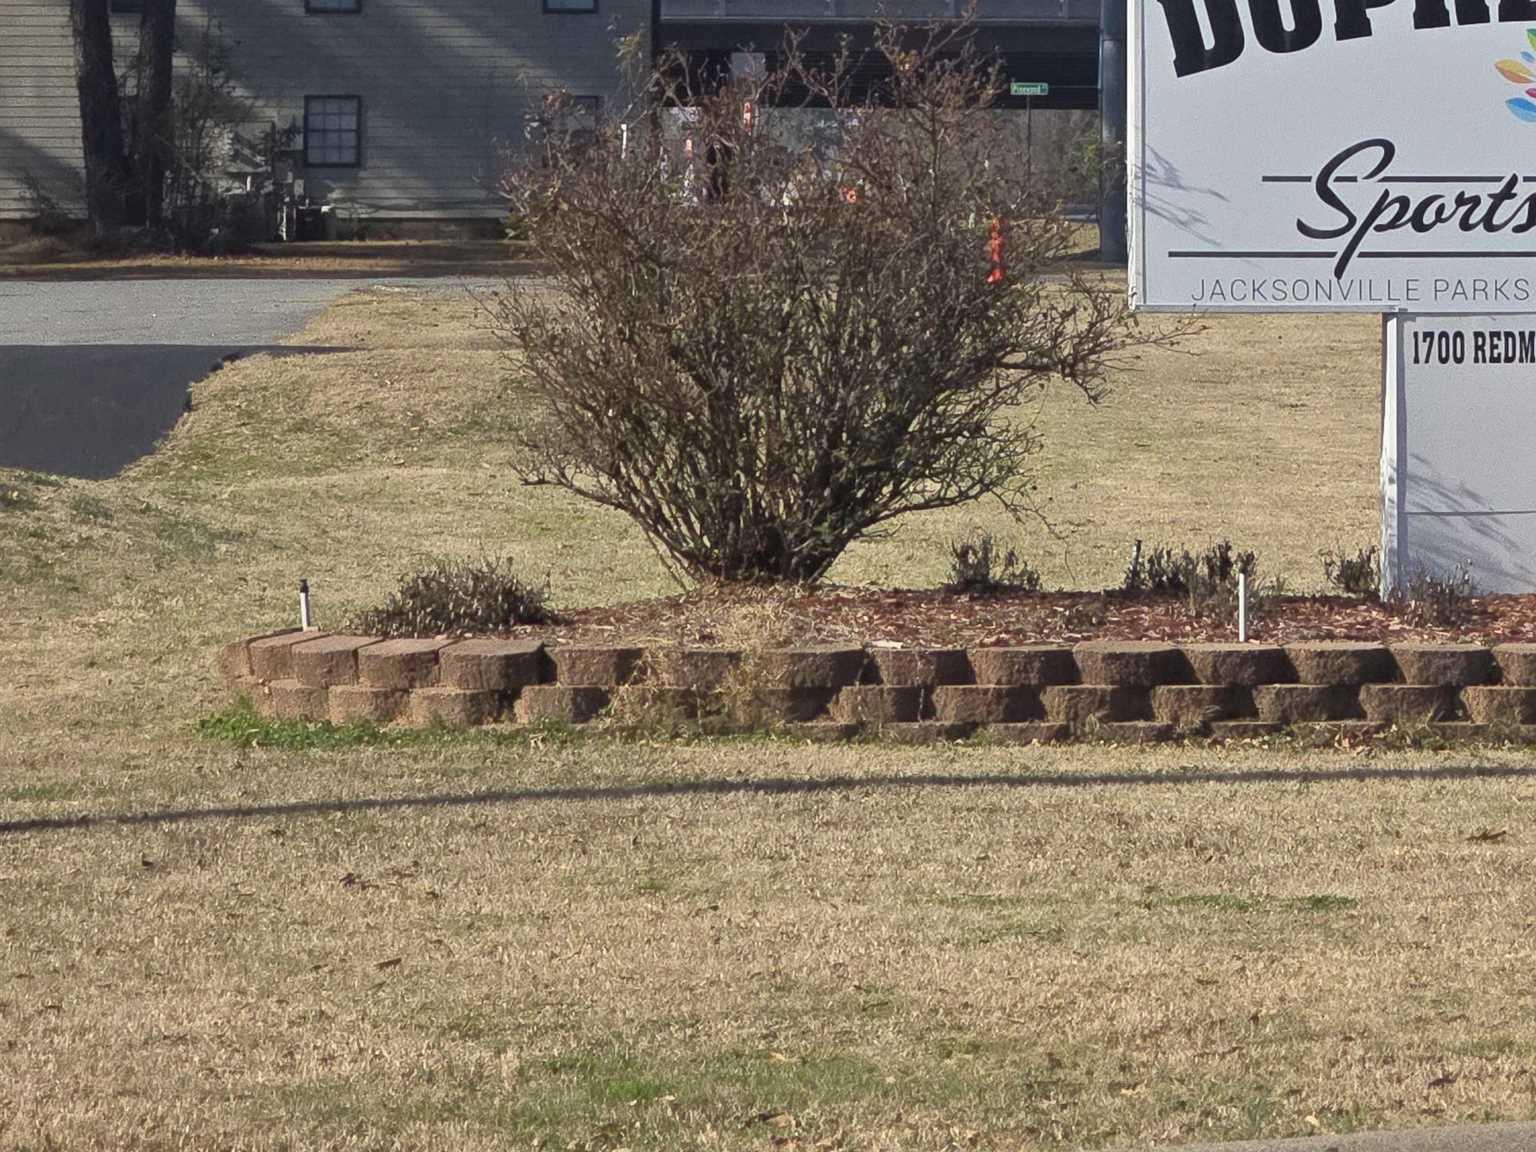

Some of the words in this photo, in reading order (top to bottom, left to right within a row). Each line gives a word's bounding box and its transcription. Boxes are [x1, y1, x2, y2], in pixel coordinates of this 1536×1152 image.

[1191, 278, 1420, 303] JACKSONVILLE
[1433, 278, 1530, 302] PARKS
[1412, 331, 1465, 365] 1700
